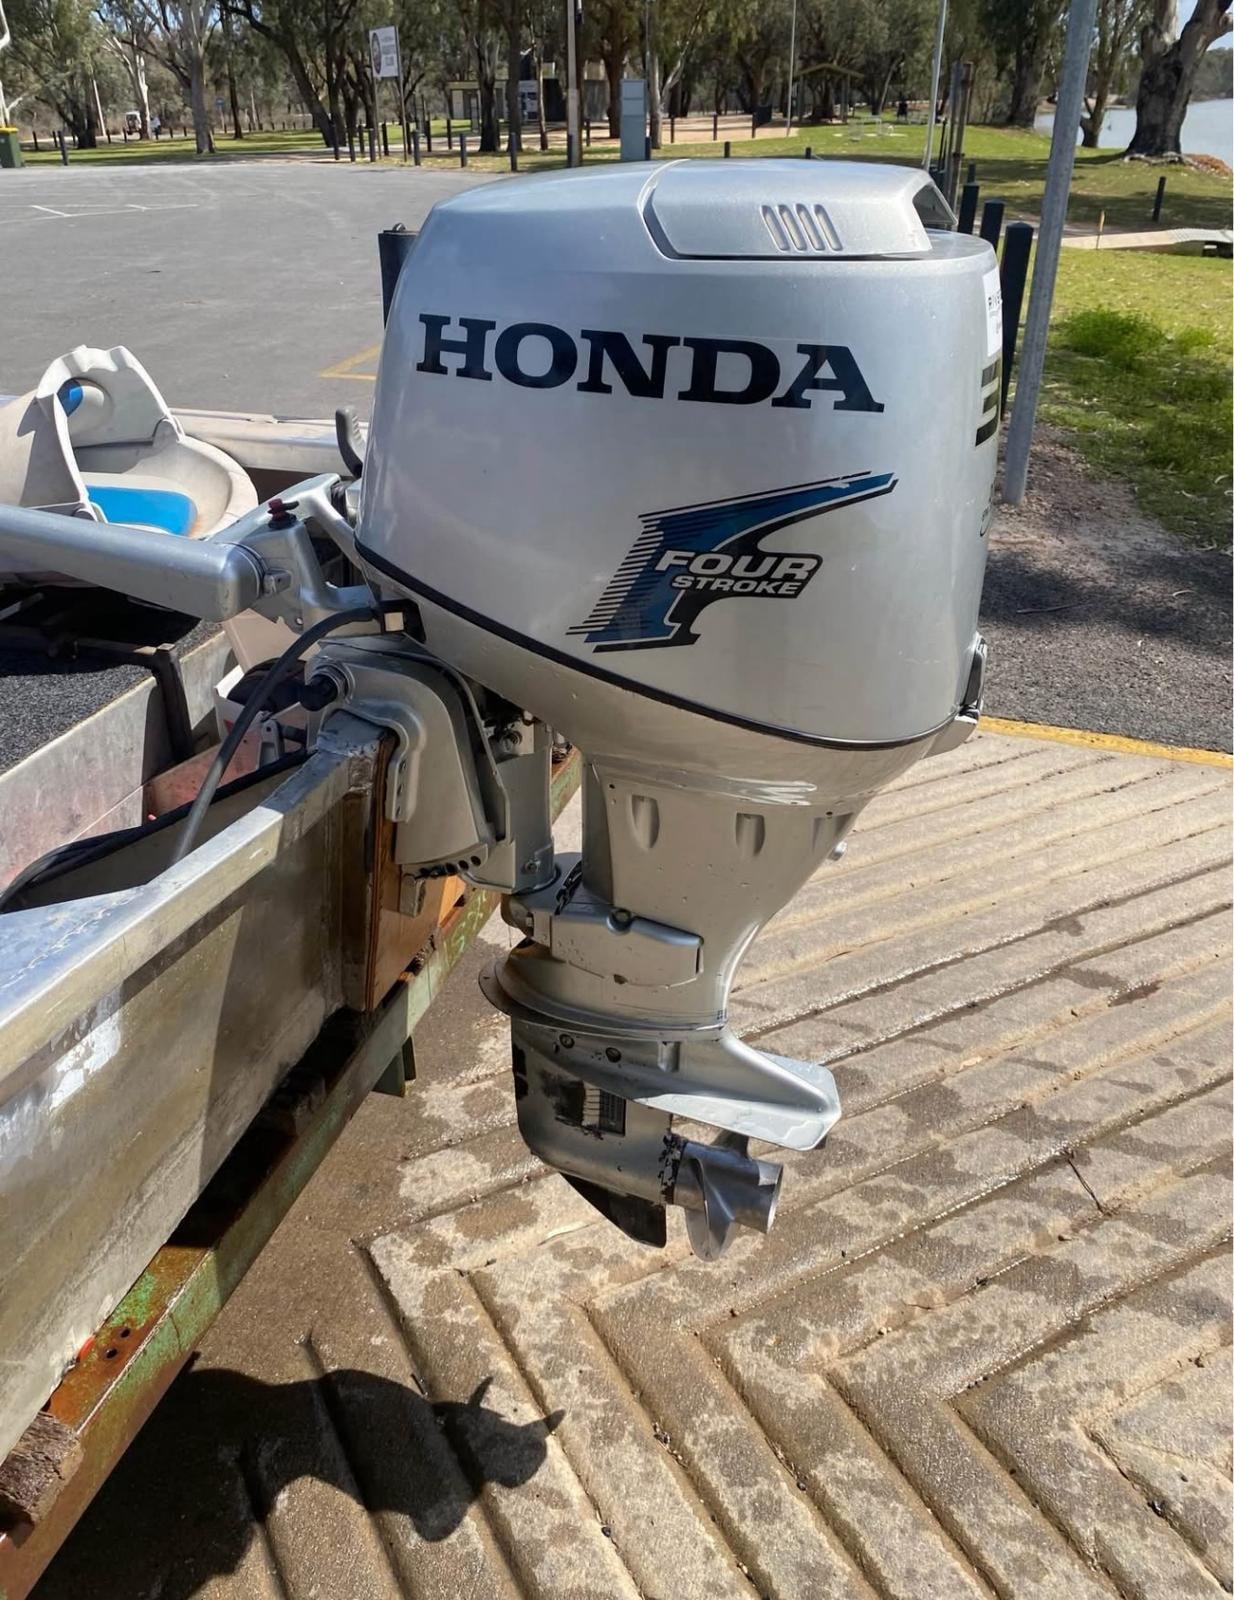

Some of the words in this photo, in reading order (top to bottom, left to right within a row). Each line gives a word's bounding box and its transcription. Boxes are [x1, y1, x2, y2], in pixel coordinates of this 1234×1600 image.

[416, 314, 885, 413] HONDA
[655, 550, 818, 580] FOUR
[671, 575, 802, 595] STROKE
